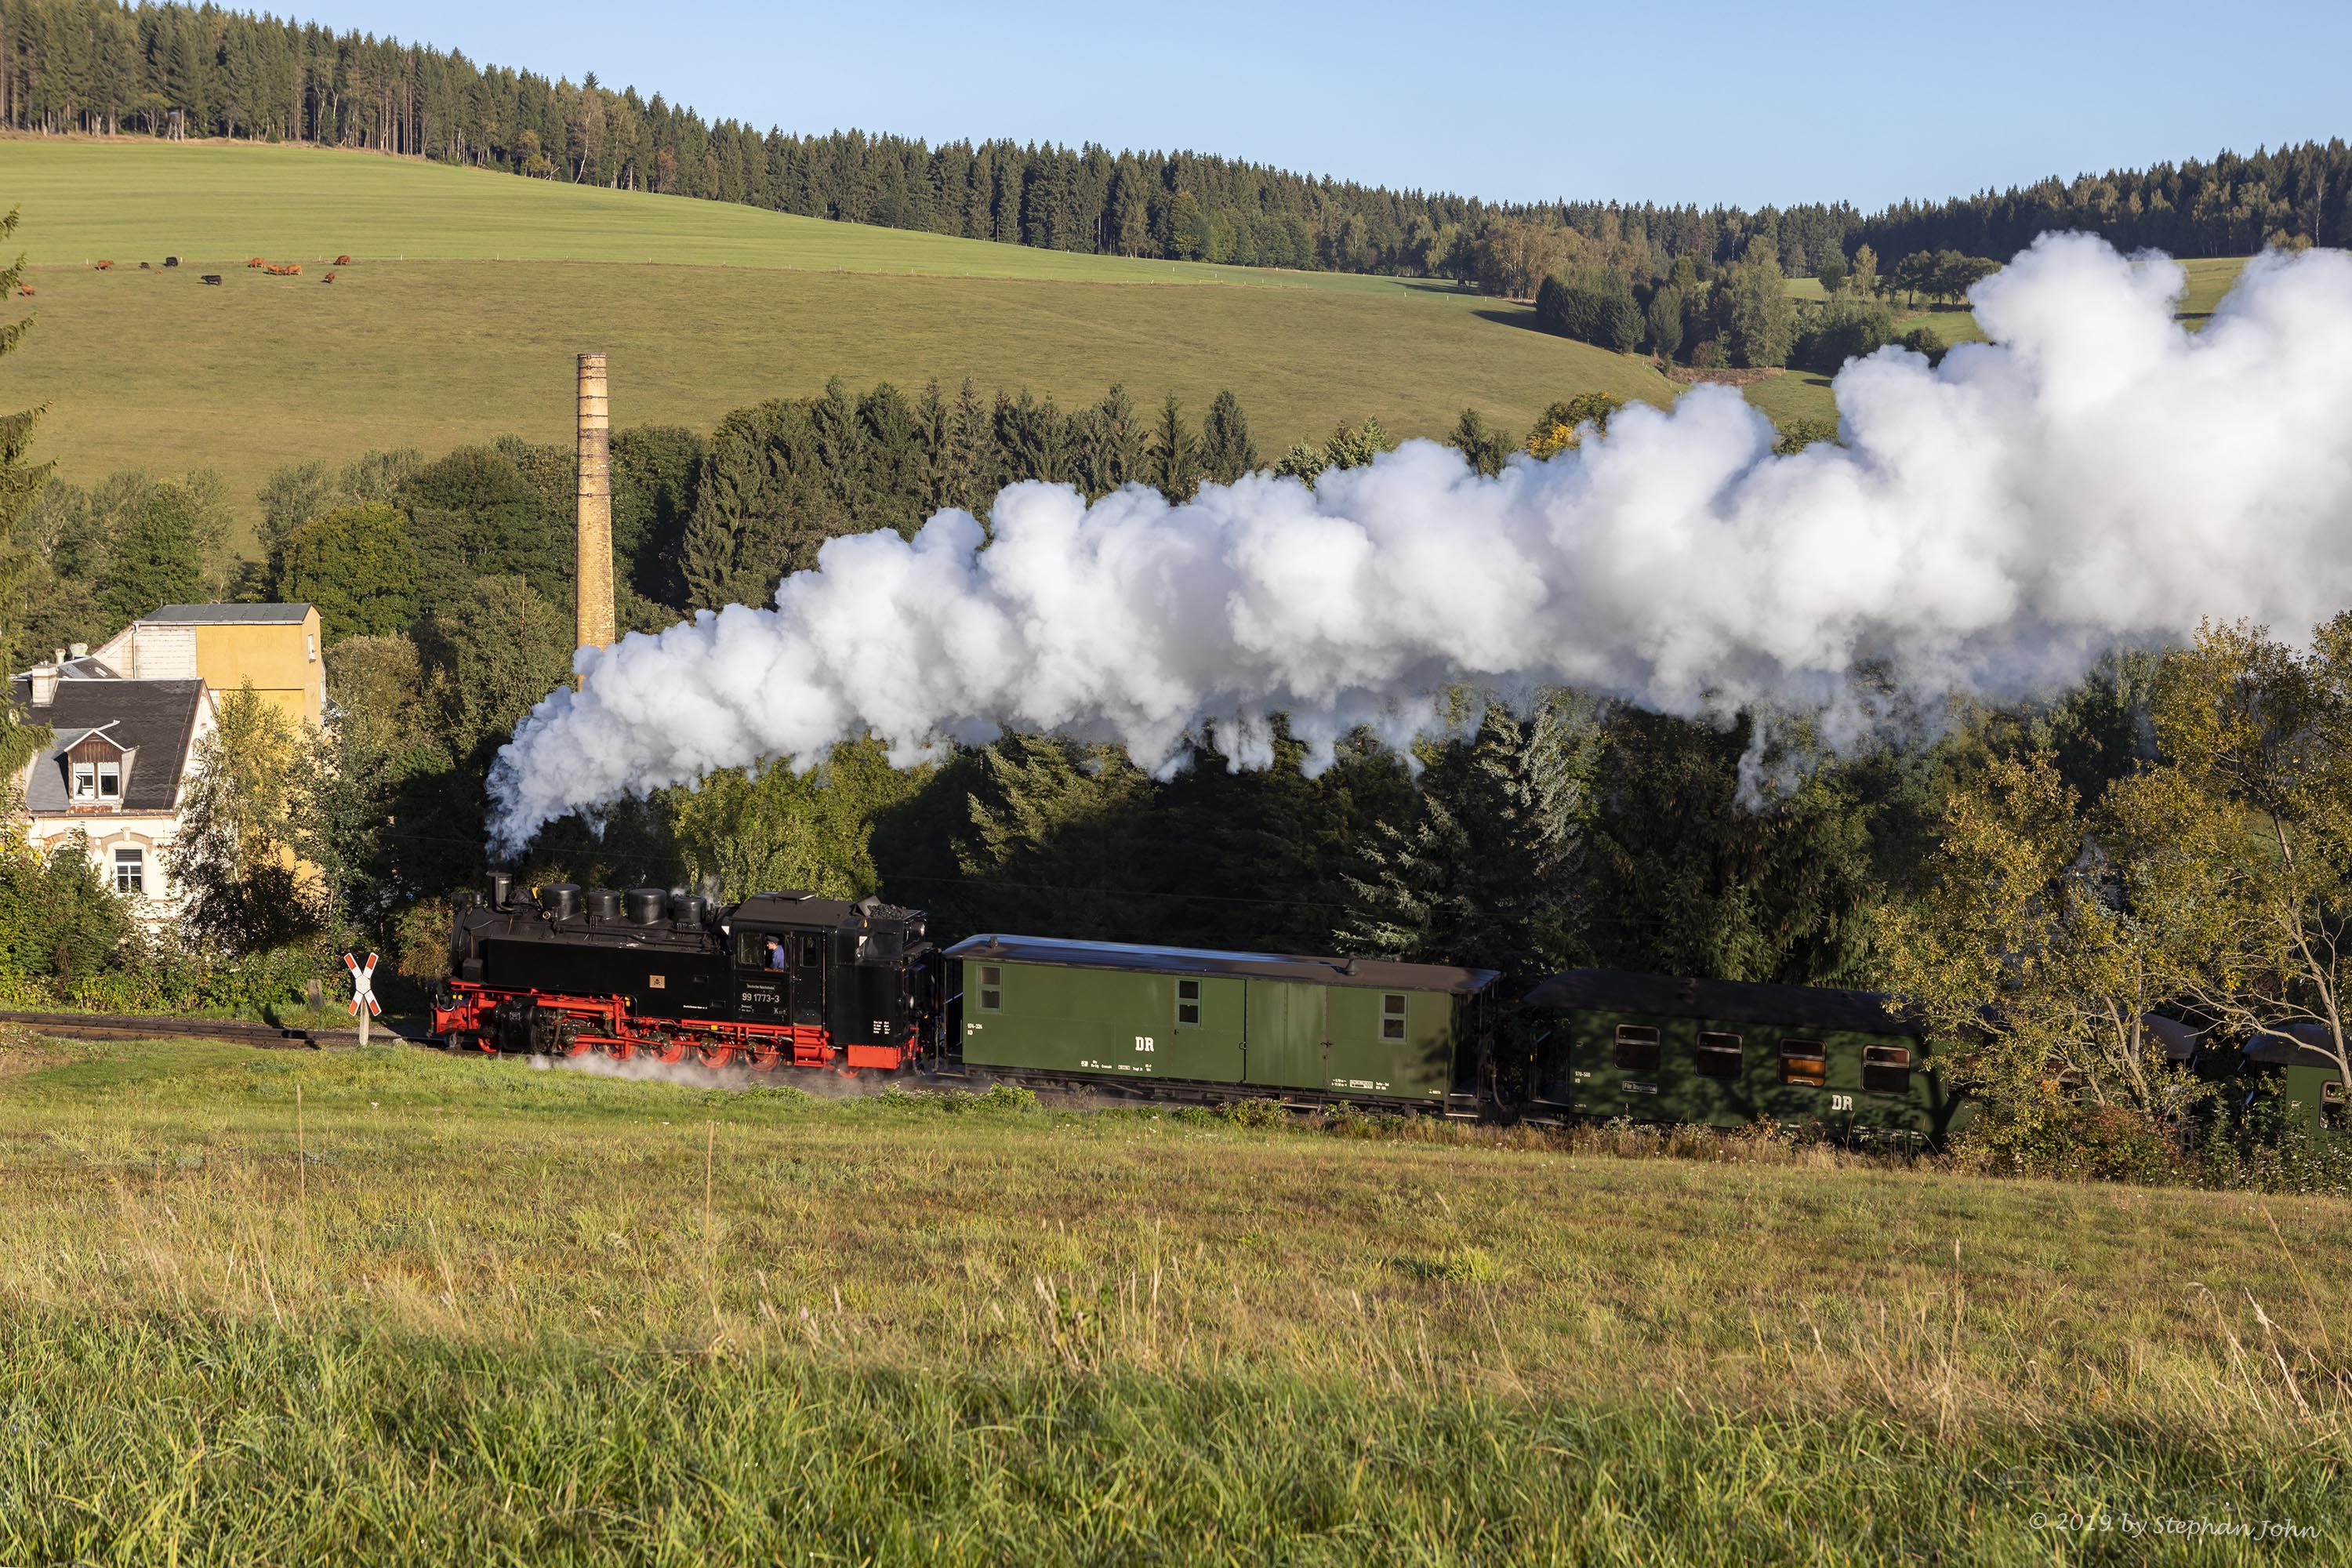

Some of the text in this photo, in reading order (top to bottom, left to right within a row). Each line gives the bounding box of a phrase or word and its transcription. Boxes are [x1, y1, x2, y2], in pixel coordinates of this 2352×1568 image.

[742, 993, 780, 1004] 99 1773-3
[1134, 1036, 1155, 1052] DR
[1831, 1094, 1853, 1112] DR
